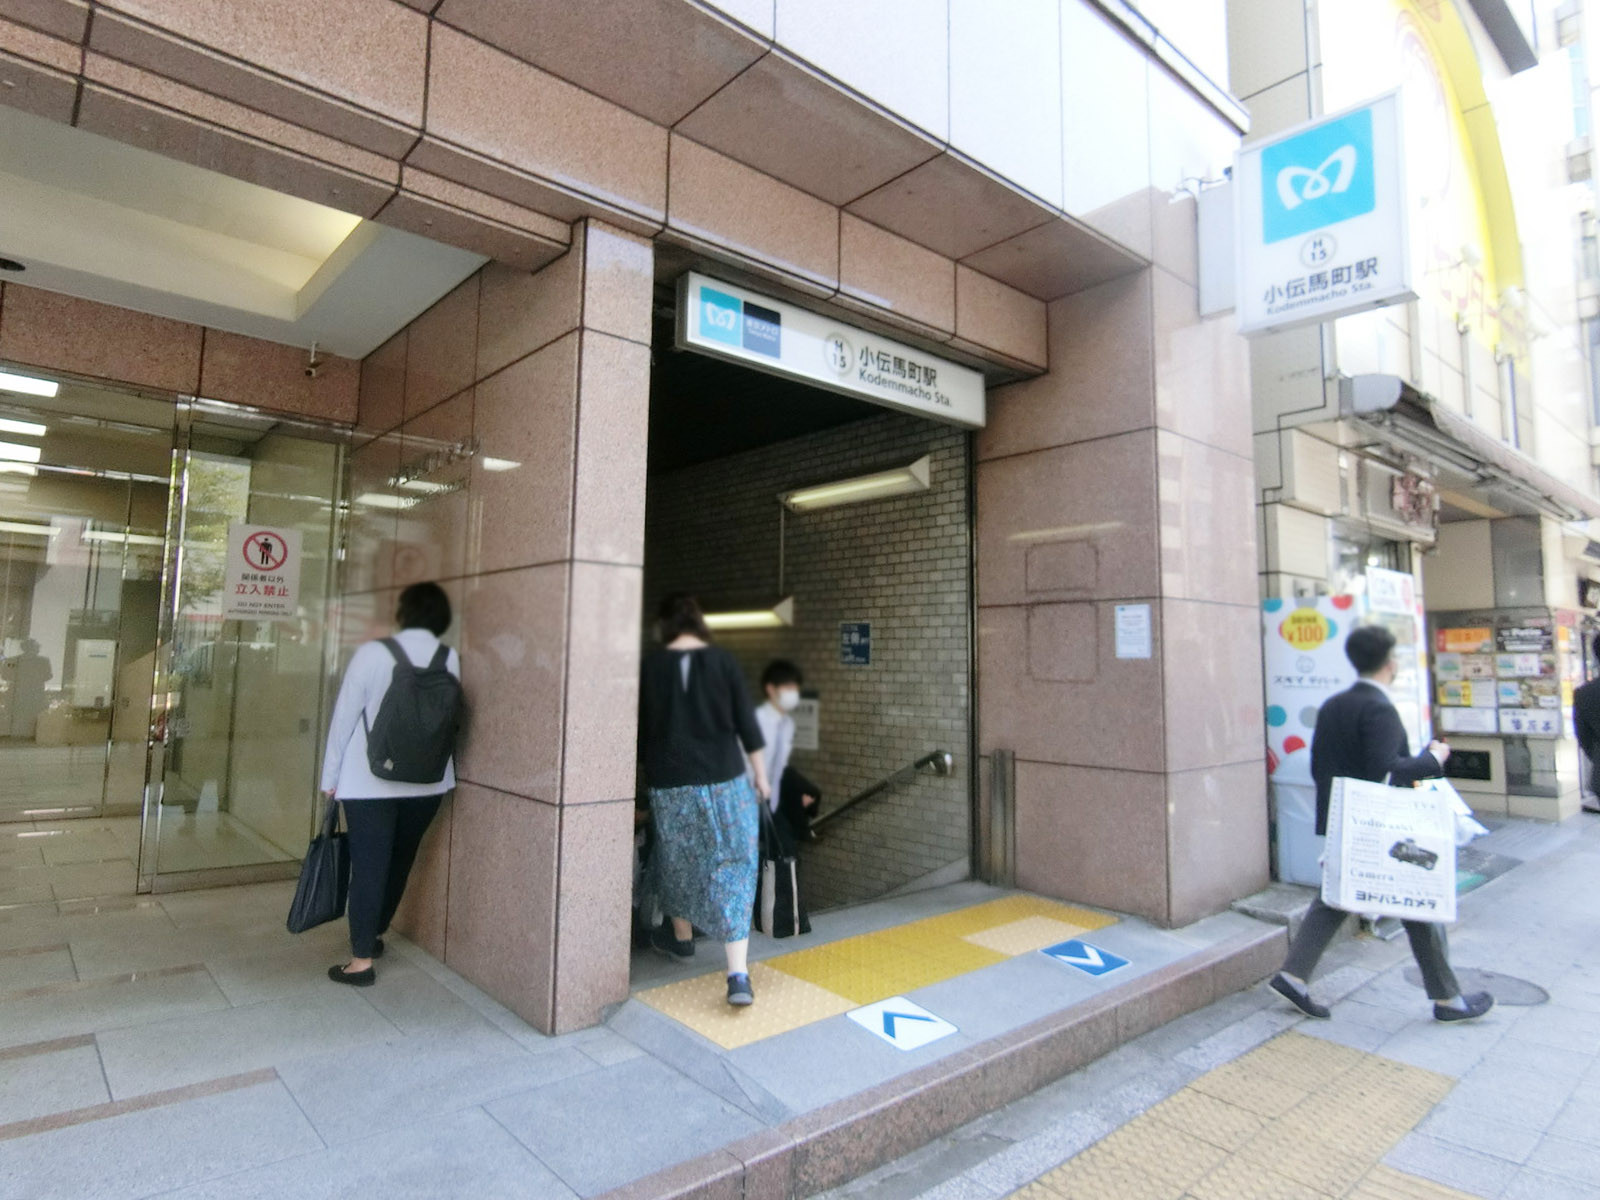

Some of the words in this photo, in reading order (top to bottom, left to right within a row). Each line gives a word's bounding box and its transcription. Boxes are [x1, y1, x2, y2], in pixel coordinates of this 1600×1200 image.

[1313, 239, 1322, 249] H
[1310, 248, 1327, 262] 15
[1264, 256, 1379, 305] 小伝馬町駅
[1266, 288, 1348, 315] Kodemmacho
[832, 352, 847, 369] 15
[859, 345, 938, 388] 小伝馬町駅
[859, 368, 932, 402] Kodemmacho
[934, 390, 953, 407] Sta.
[235, 583, 290, 597] 立入禁止
[1355, 890, 1438, 909] ヨドバシカメラ
